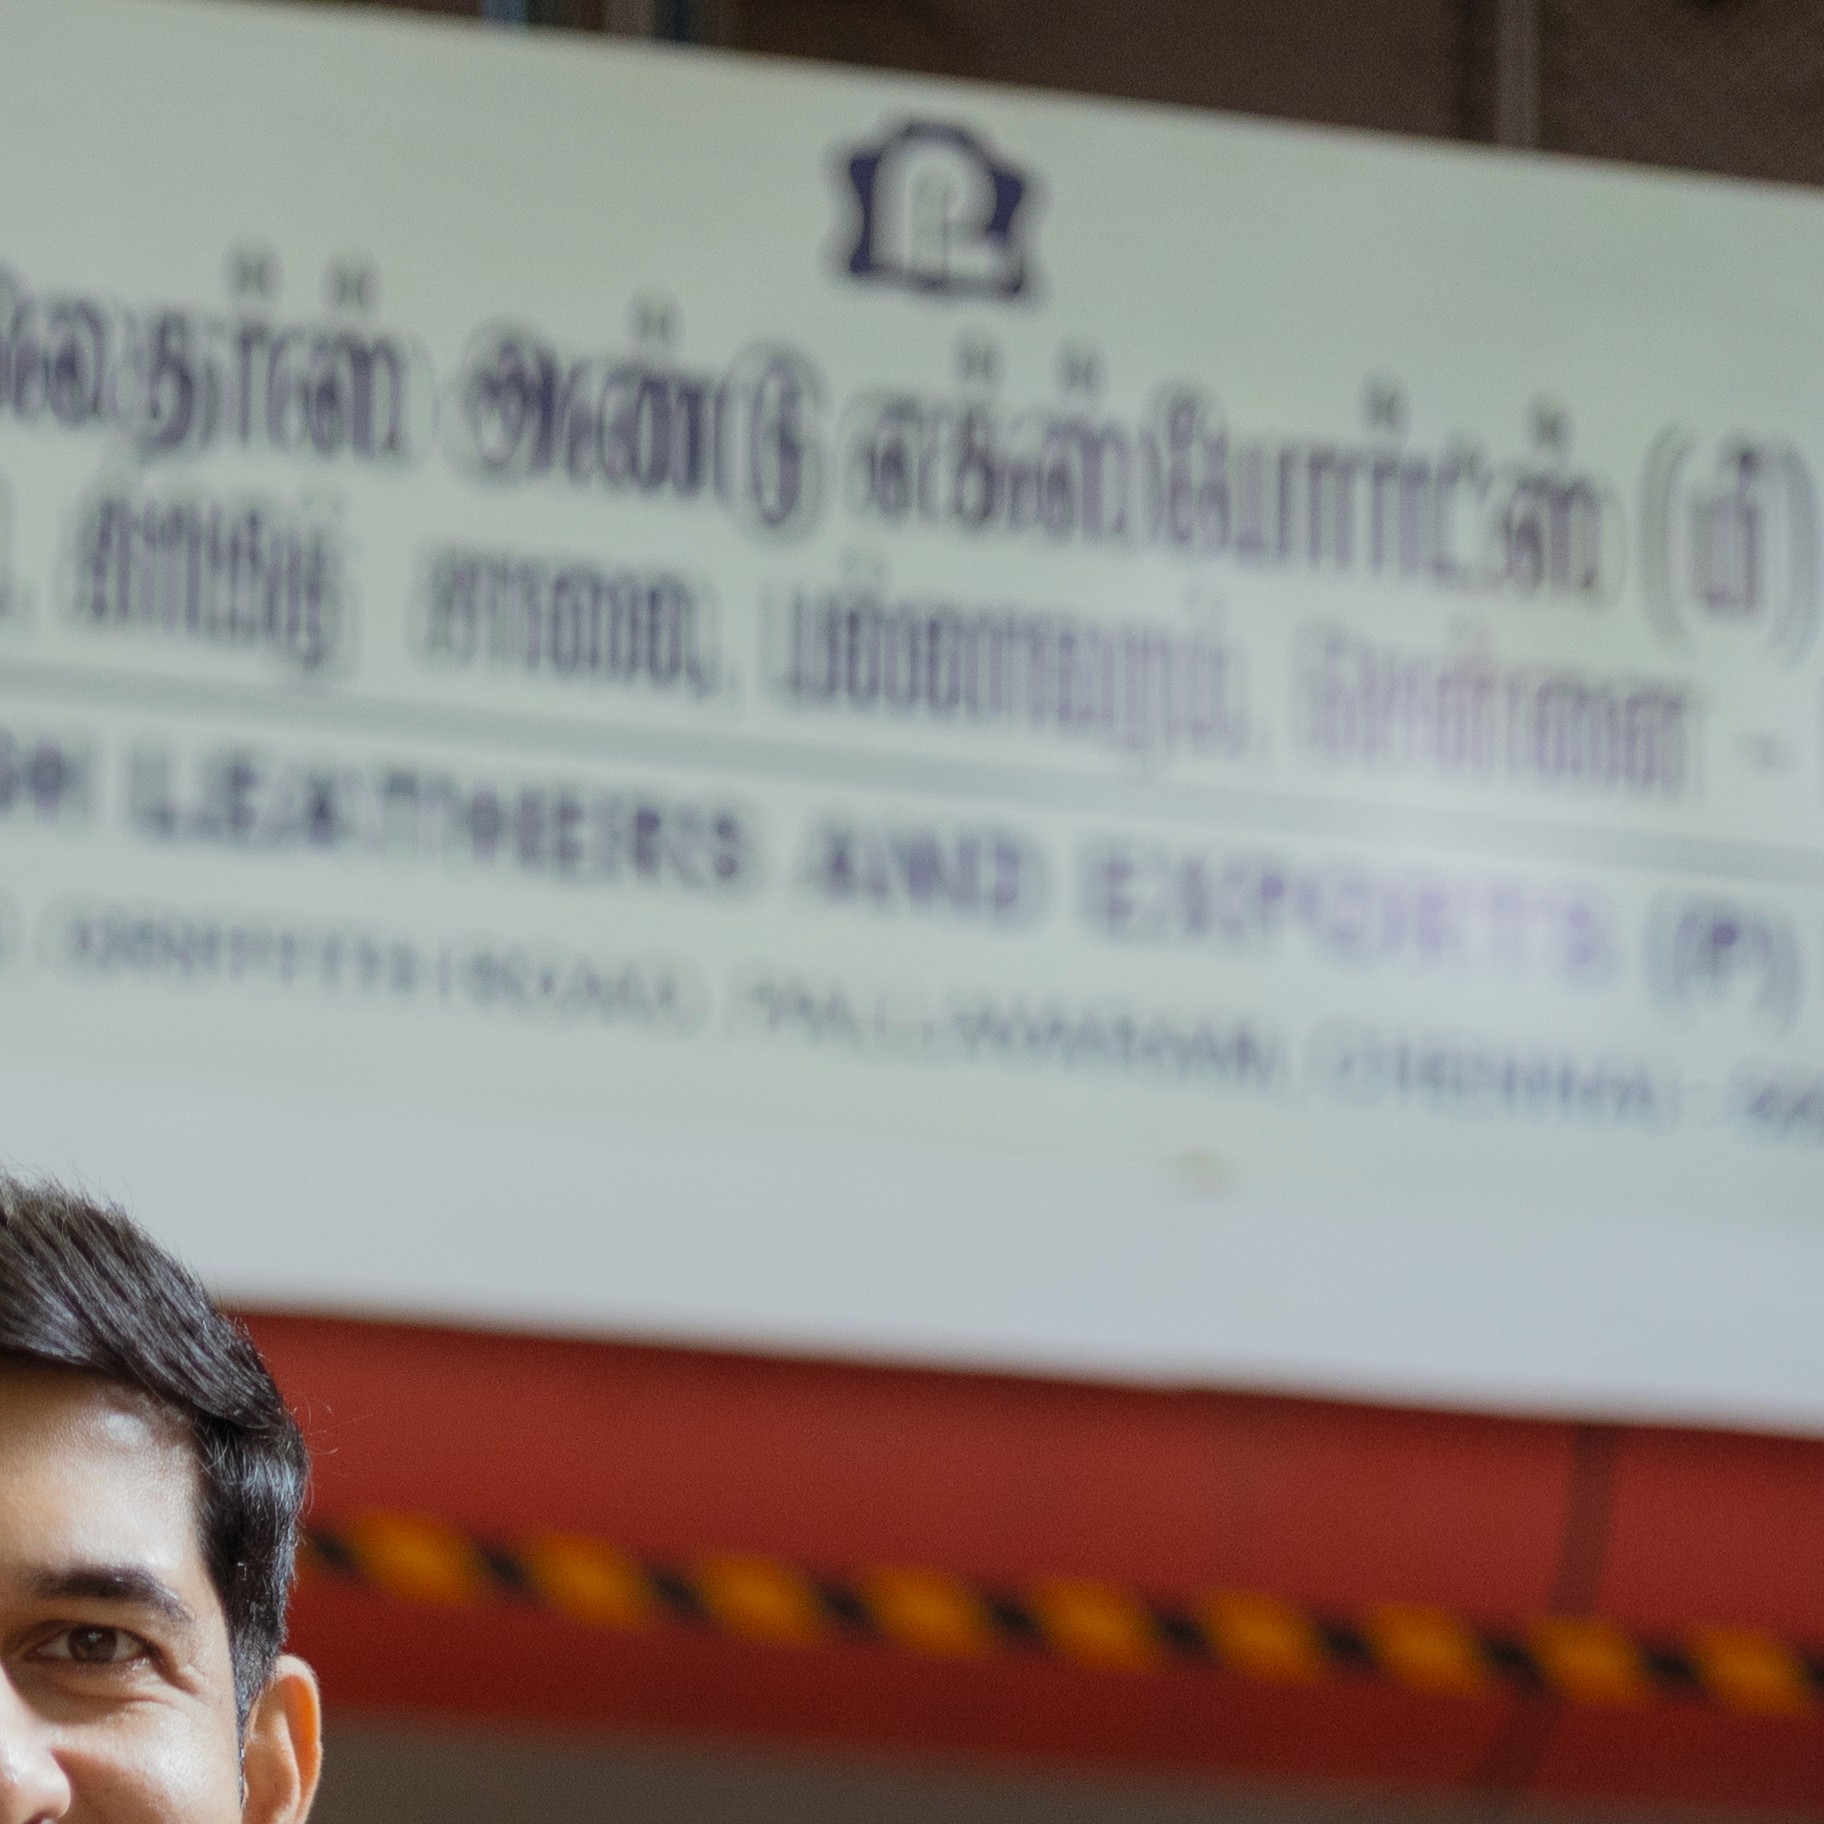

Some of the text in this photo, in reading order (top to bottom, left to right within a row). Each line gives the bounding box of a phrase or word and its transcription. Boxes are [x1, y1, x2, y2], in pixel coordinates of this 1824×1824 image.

[459, 303, 821, 539] அண்டு
[139, 743, 753, 897] LEATHERS
[812, 811, 1040, 927] AND
[1086, 843, 1612, 984] EXPORTS
